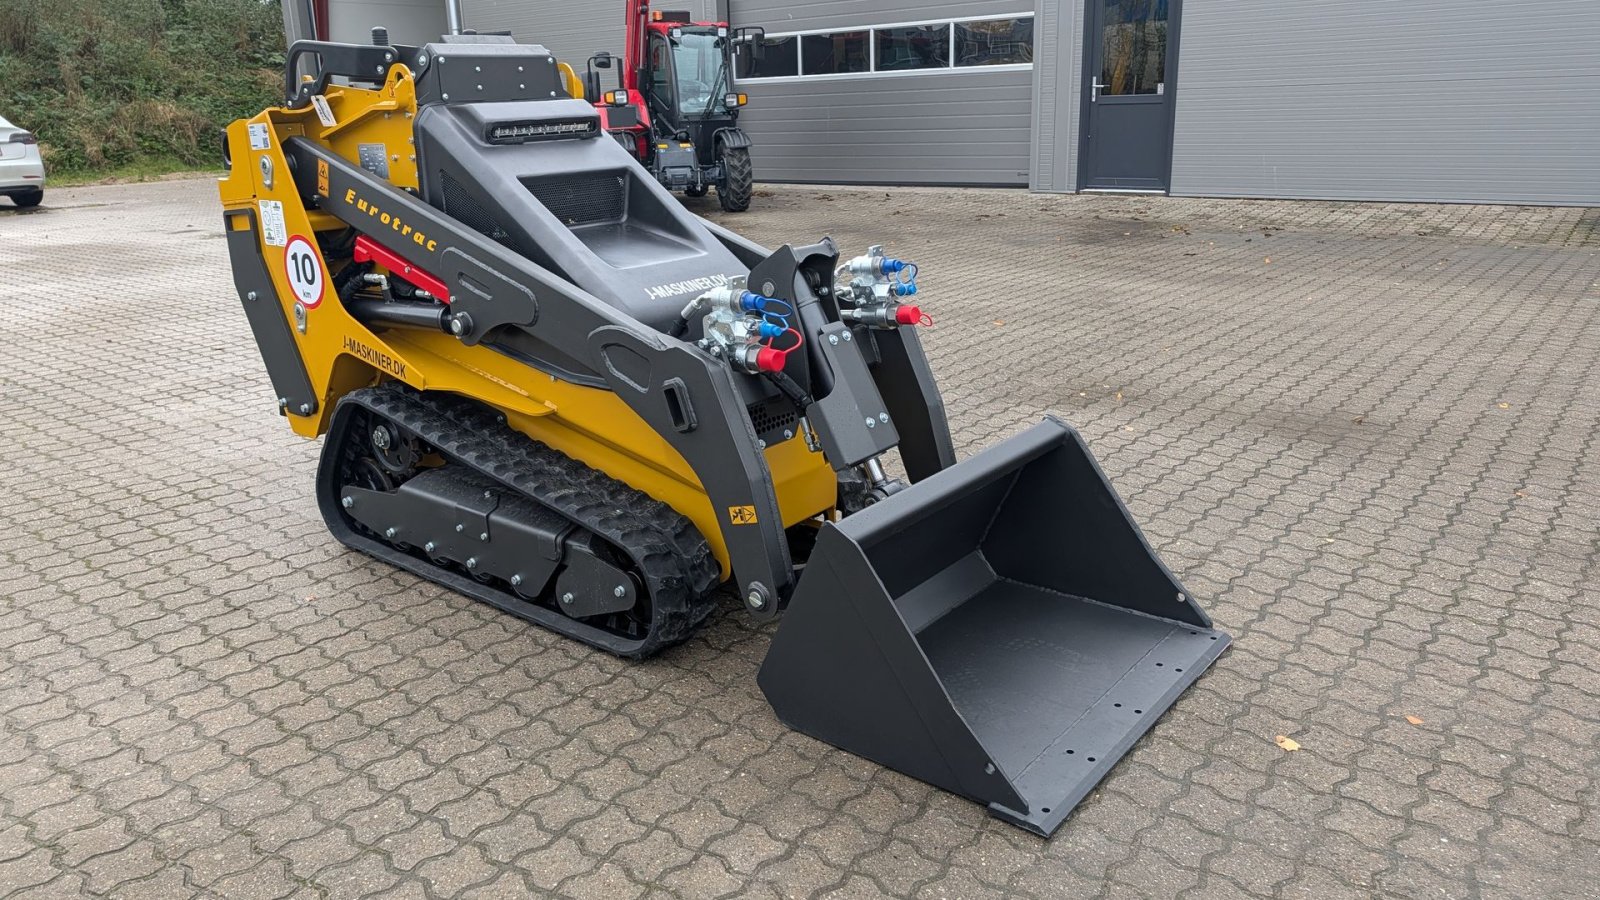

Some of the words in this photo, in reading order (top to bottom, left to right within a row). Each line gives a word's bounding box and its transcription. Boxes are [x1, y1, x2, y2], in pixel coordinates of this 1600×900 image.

[345, 188, 437, 252] Eurotrac
[291, 252, 316, 286] 10
[303, 289, 312, 299] km
[644, 274, 730, 300] J-MASKINER.DK
[343, 334, 407, 380] J-MASKINER.DK
